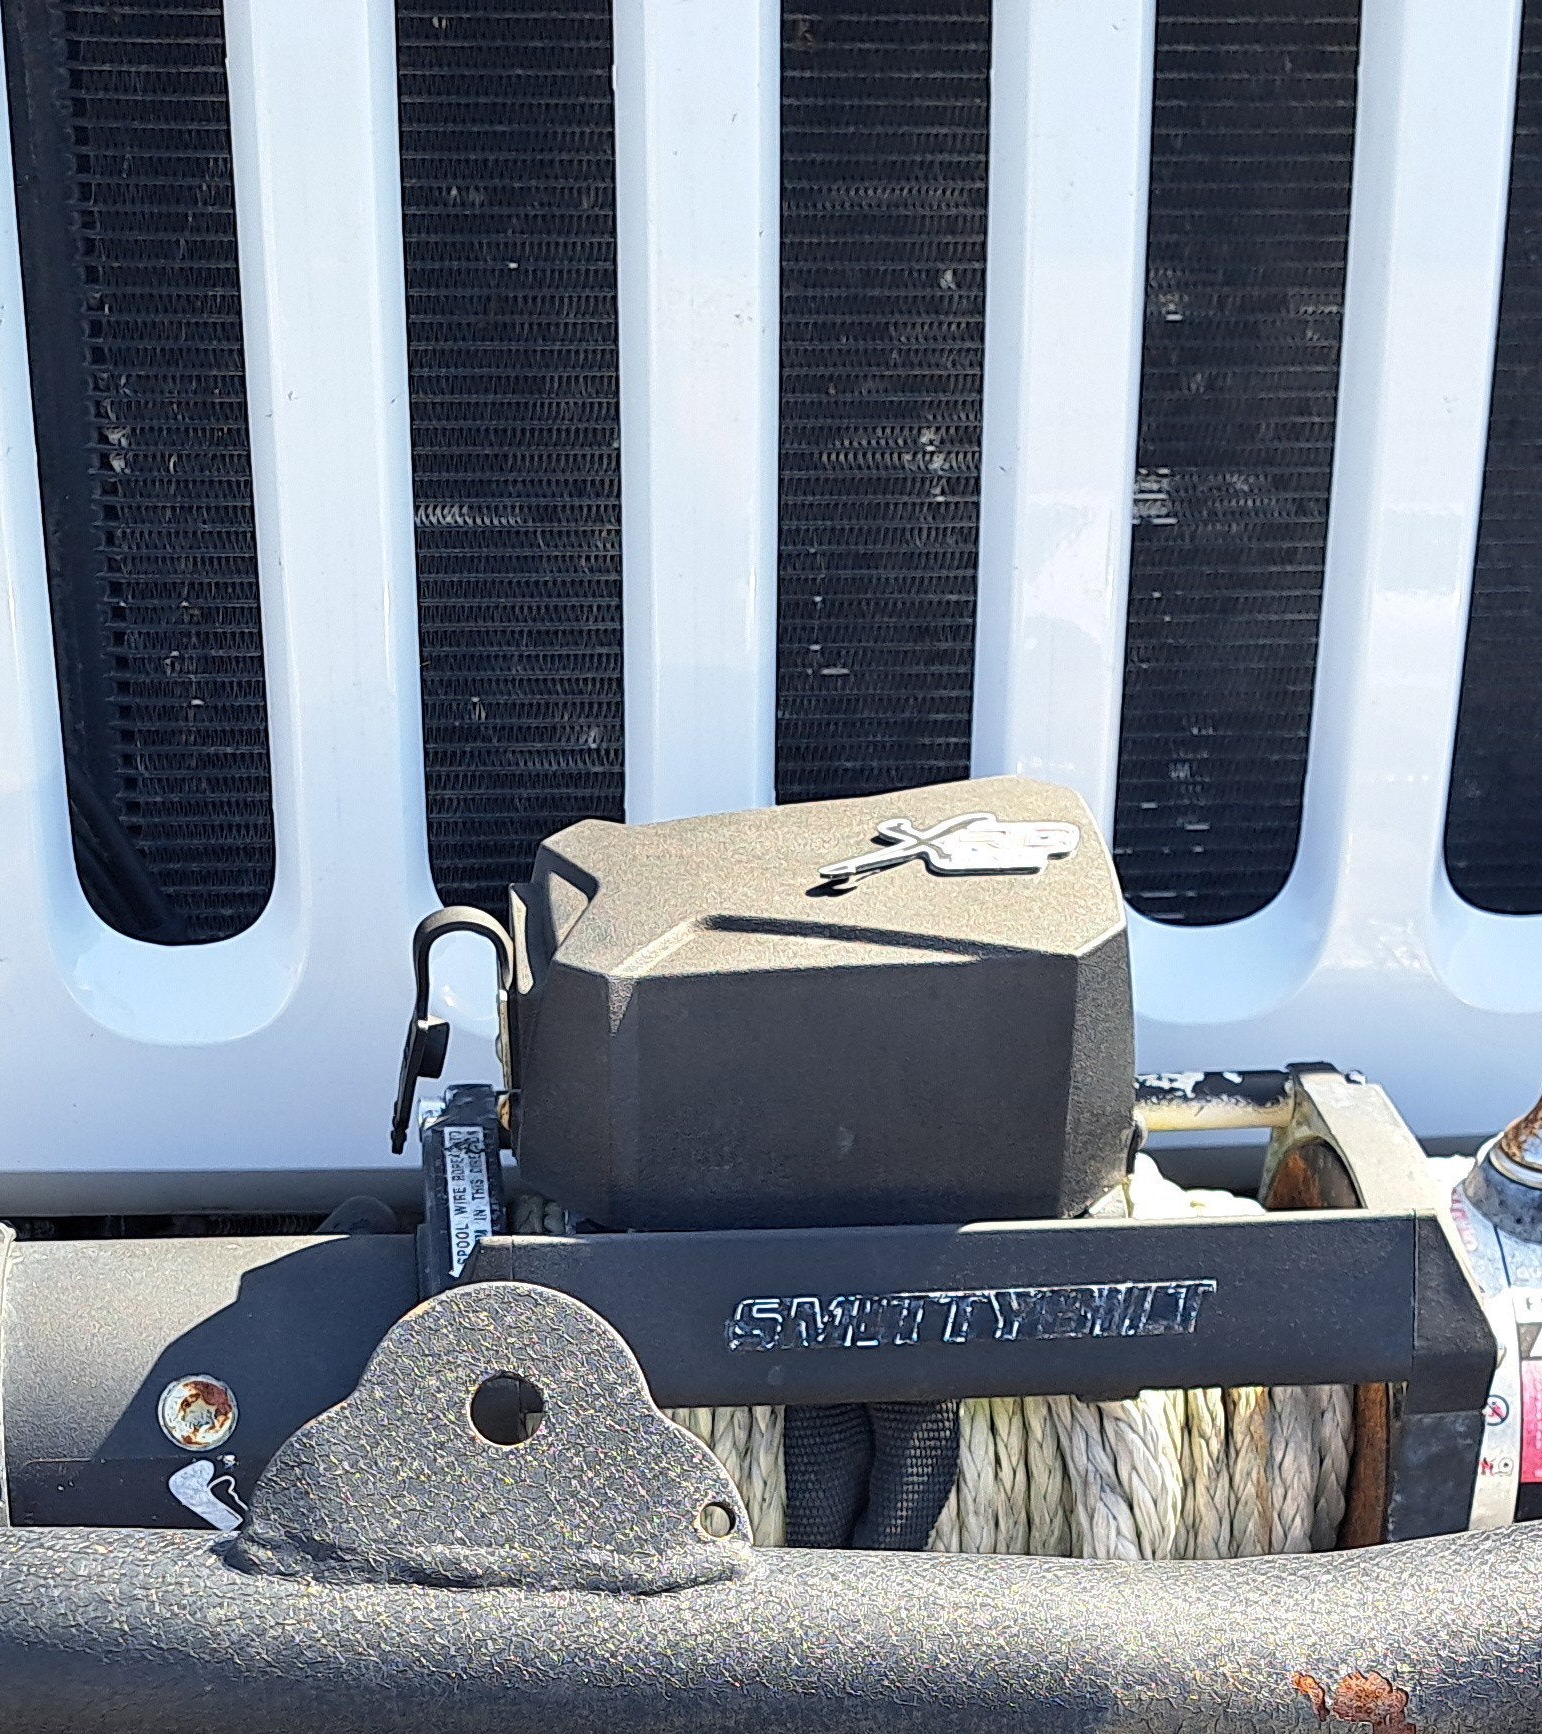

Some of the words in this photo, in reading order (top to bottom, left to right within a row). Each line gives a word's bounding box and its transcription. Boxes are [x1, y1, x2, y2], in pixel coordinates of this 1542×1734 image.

[453, 1187, 469, 1216] WIRE
[472, 1208, 488, 1221] IN
[455, 1222, 470, 1265] SPOOL
[726, 1279, 1217, 1352] SMITTYBILT
